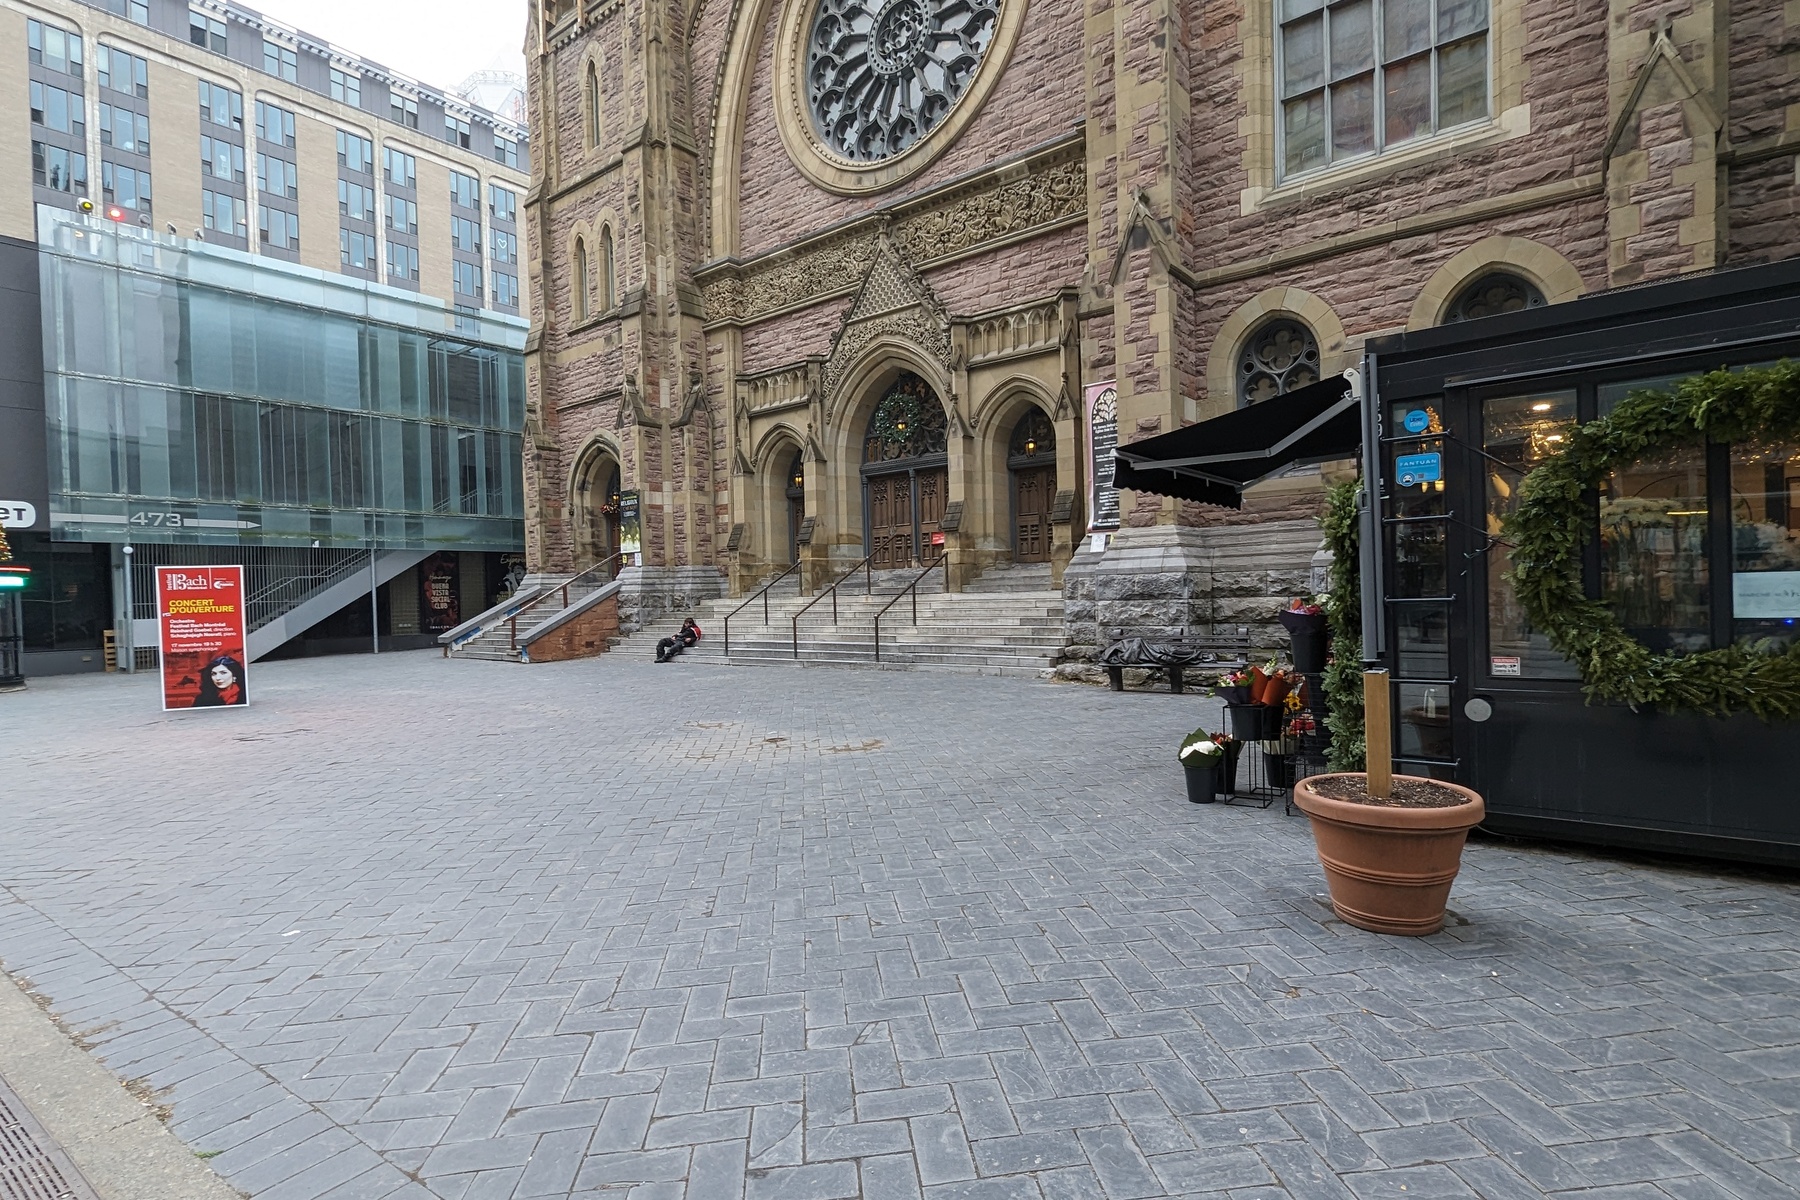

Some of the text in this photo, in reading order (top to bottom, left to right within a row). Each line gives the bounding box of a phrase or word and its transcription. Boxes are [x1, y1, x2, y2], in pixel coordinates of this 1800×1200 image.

[1399, 459, 1437, 467] FANTUAN
[130, 511, 182, 527] 473
[172, 573, 207, 591] Bach
[169, 599, 214, 607] CONCERT
[169, 606, 235, 614] D'OUVERTURE
